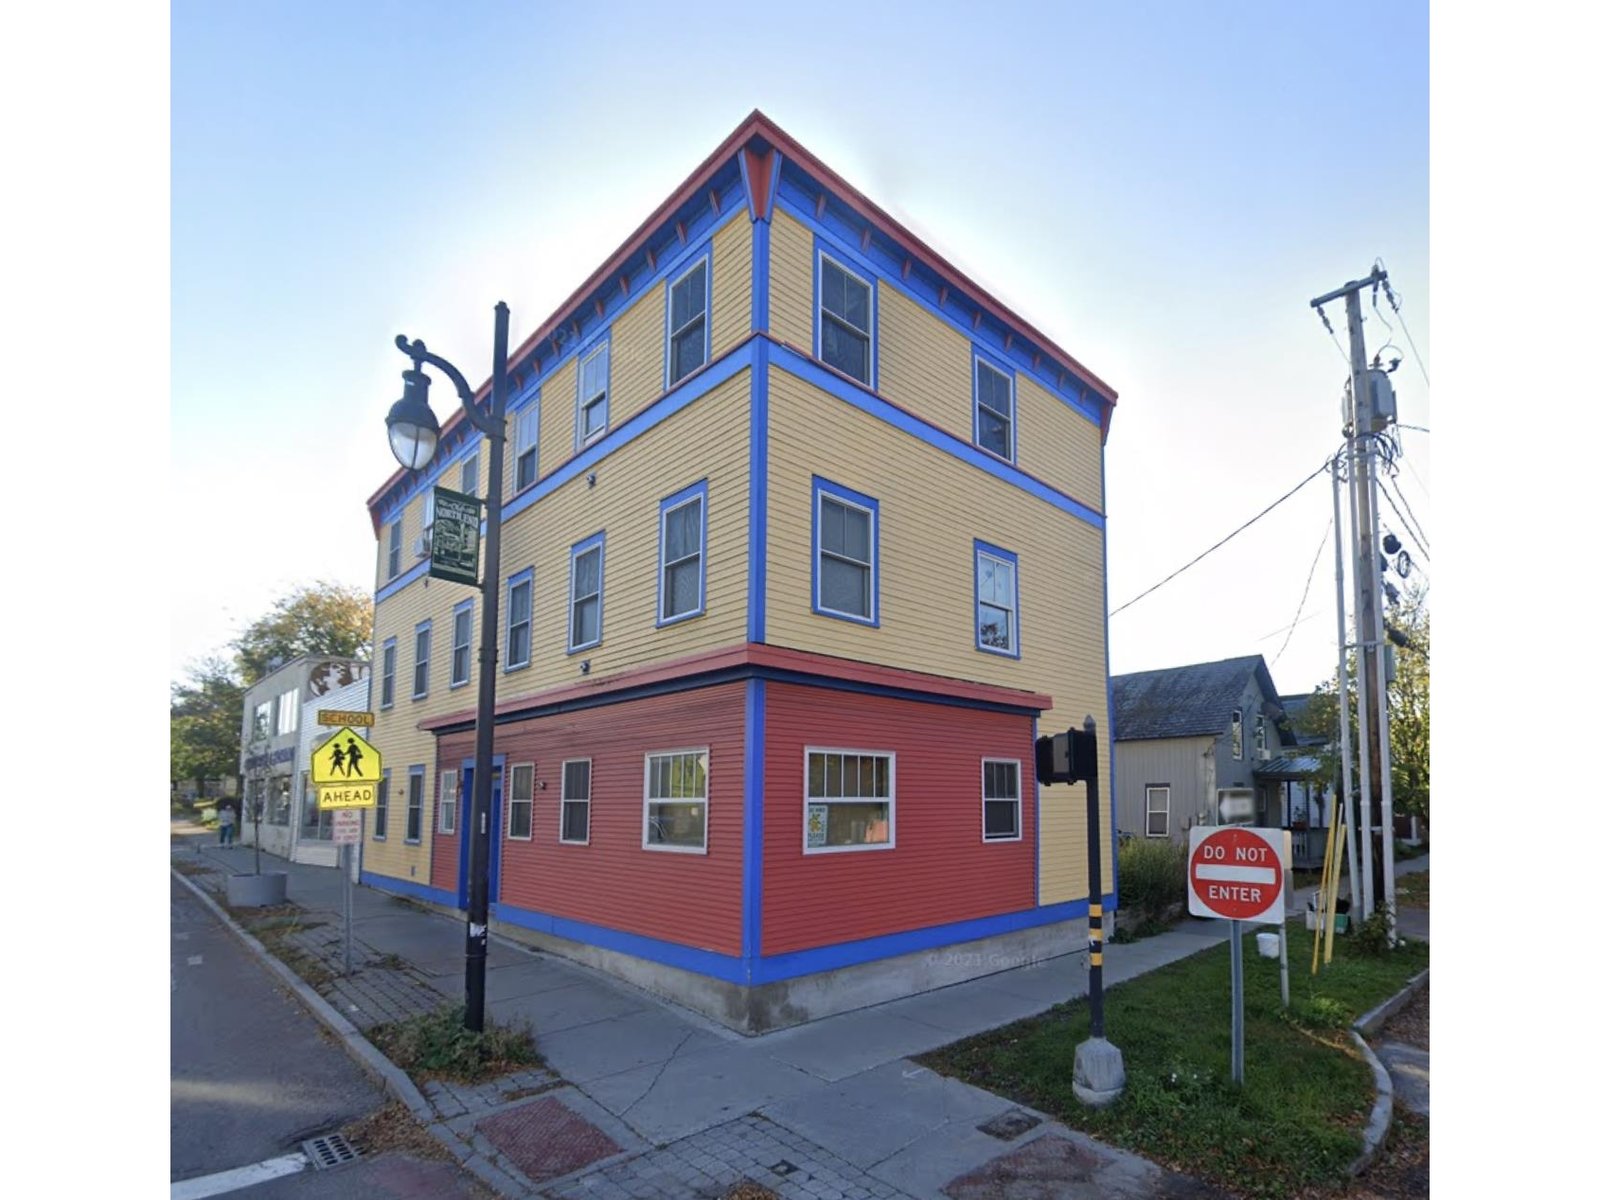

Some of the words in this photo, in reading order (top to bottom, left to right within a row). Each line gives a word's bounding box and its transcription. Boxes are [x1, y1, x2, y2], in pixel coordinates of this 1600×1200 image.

[322, 713, 371, 725] SCHOOL
[323, 789, 372, 803] AHEAD
[1203, 845, 1225, 860] DO
[1235, 847, 1268, 862] NOT
[1208, 885, 1262, 903] ENTER
